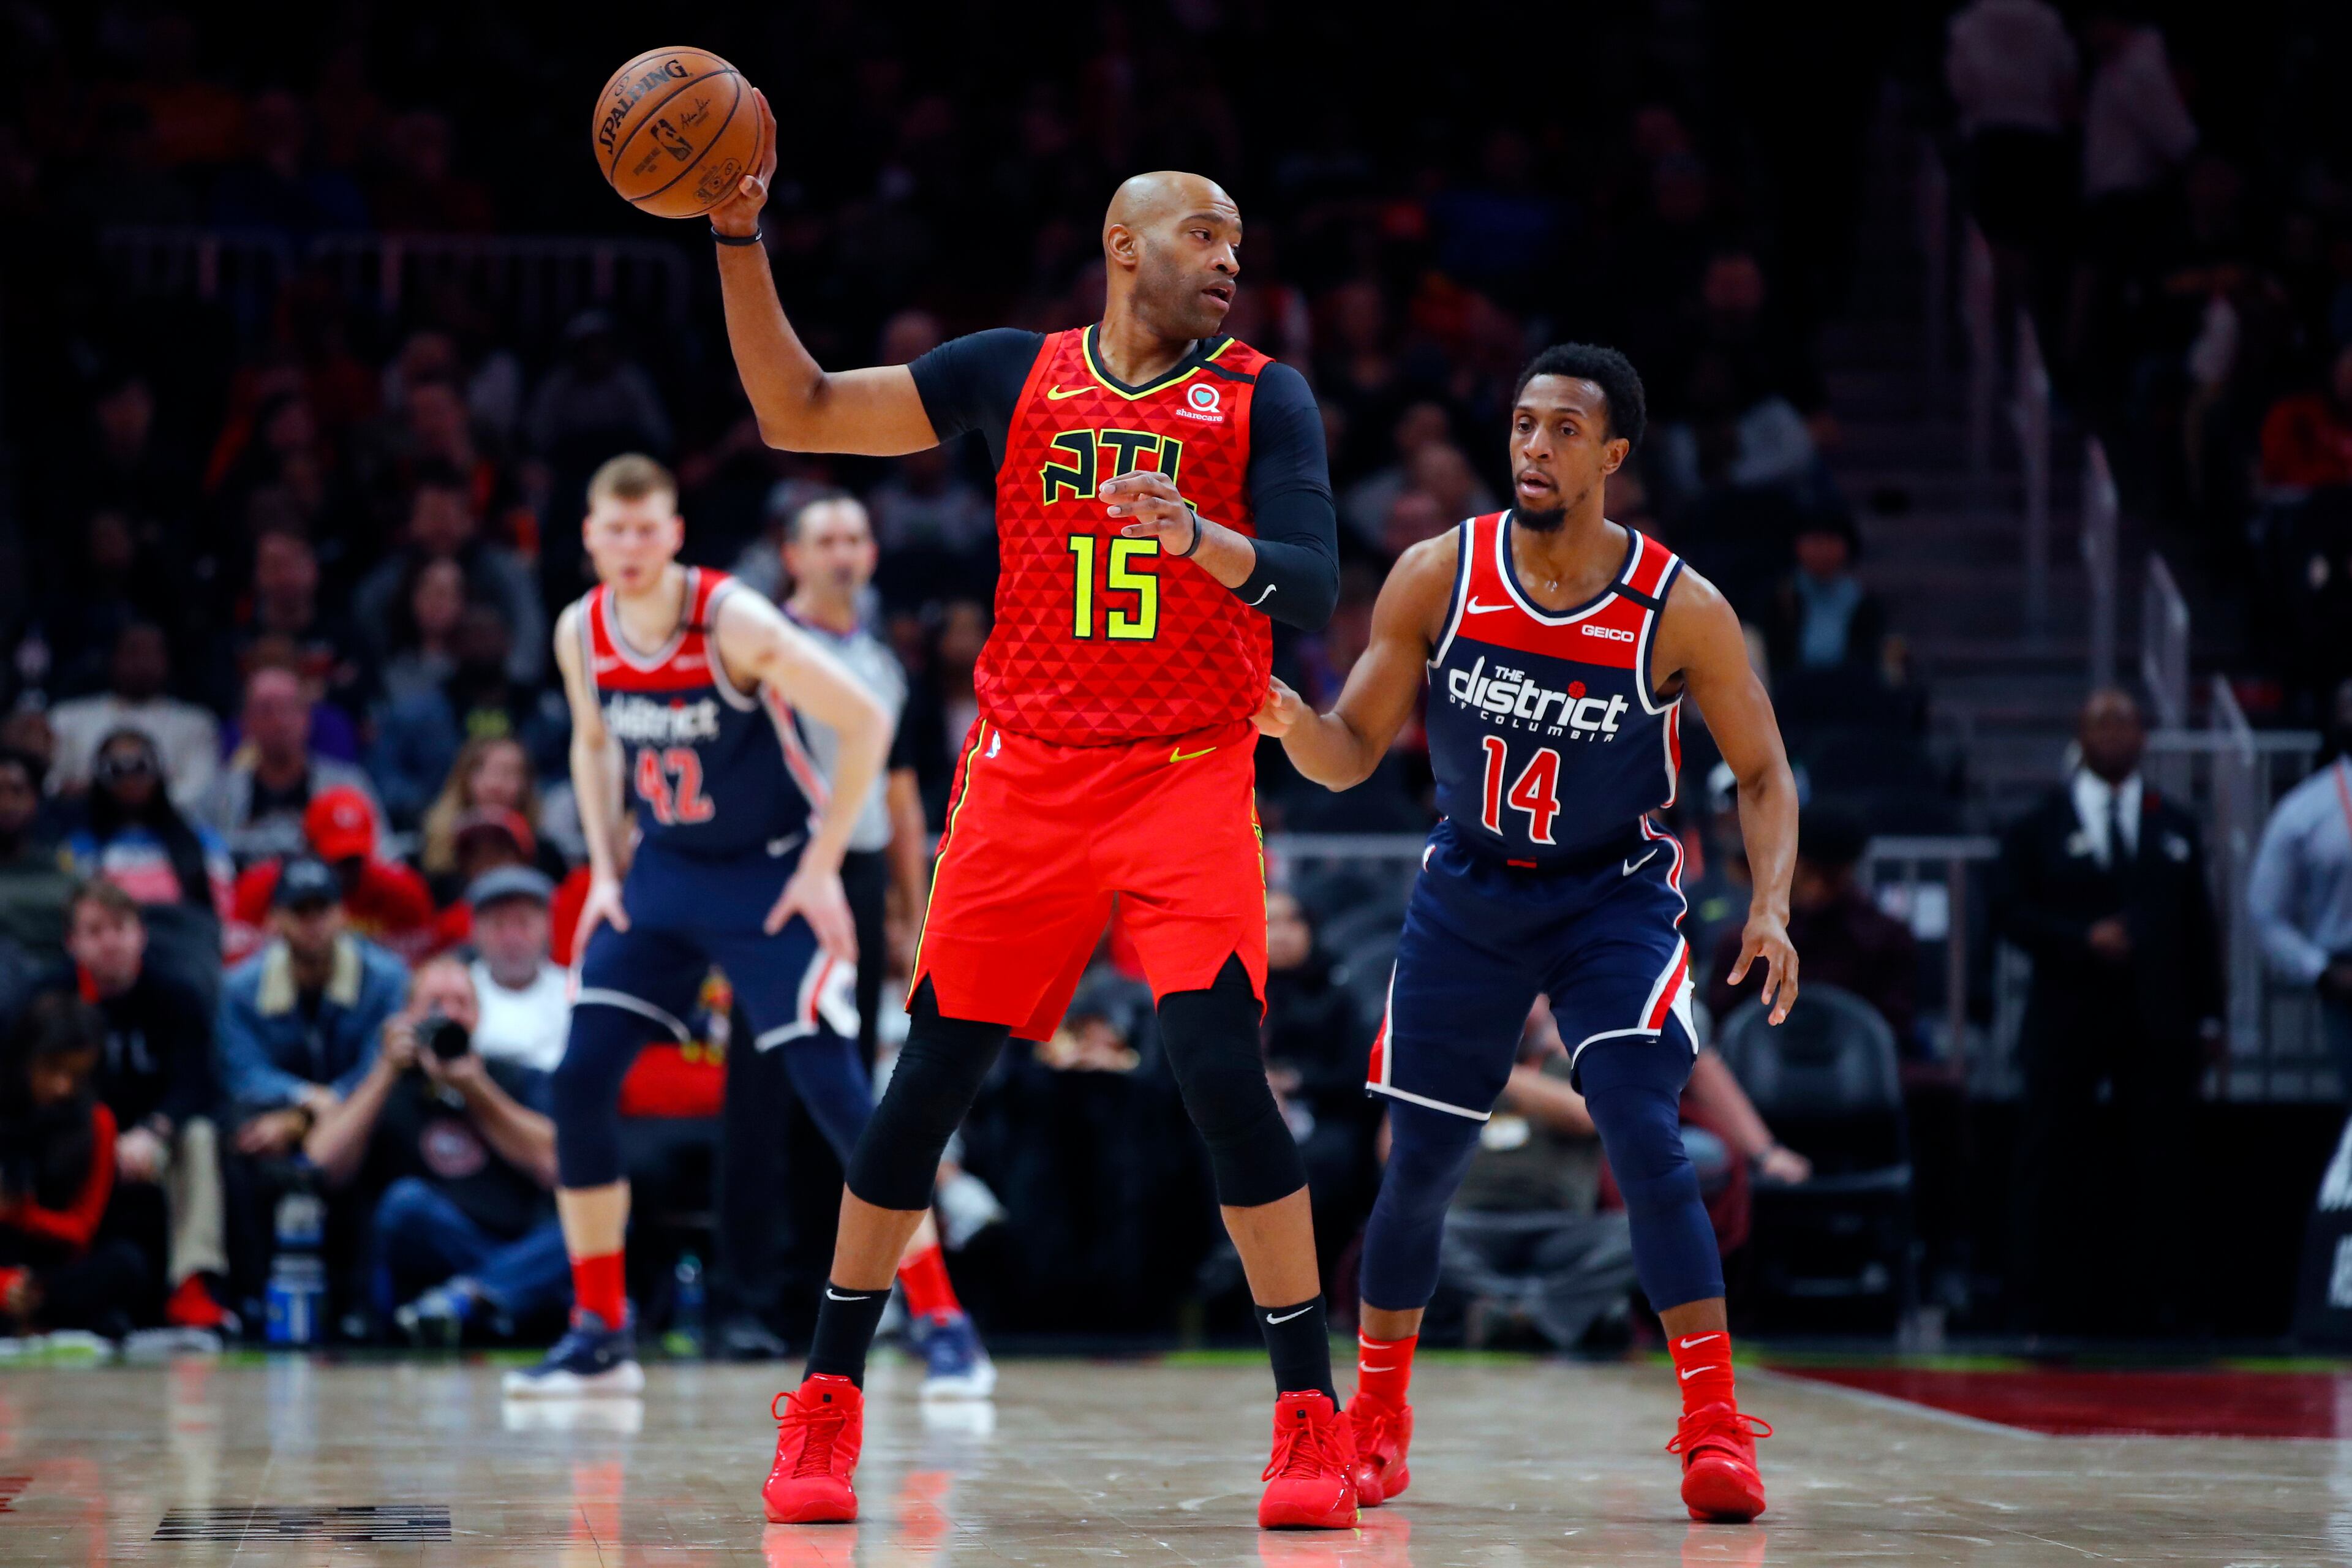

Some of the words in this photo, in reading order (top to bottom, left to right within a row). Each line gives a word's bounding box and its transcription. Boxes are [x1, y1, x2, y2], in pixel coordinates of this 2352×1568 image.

[599, 59, 688, 154] SPALDING
[1176, 409, 1223, 421] sharecare
[1067, 533, 1161, 641] 15
[1581, 625, 1635, 643] GEICO
[1449, 655, 1629, 733] district
[1495, 665, 1525, 682] THE
[1450, 694, 1468, 710] OF
[1480, 710, 1615, 742] COLUMBIA
[635, 747, 715, 825] 42
[1482, 735, 1561, 845] 14
